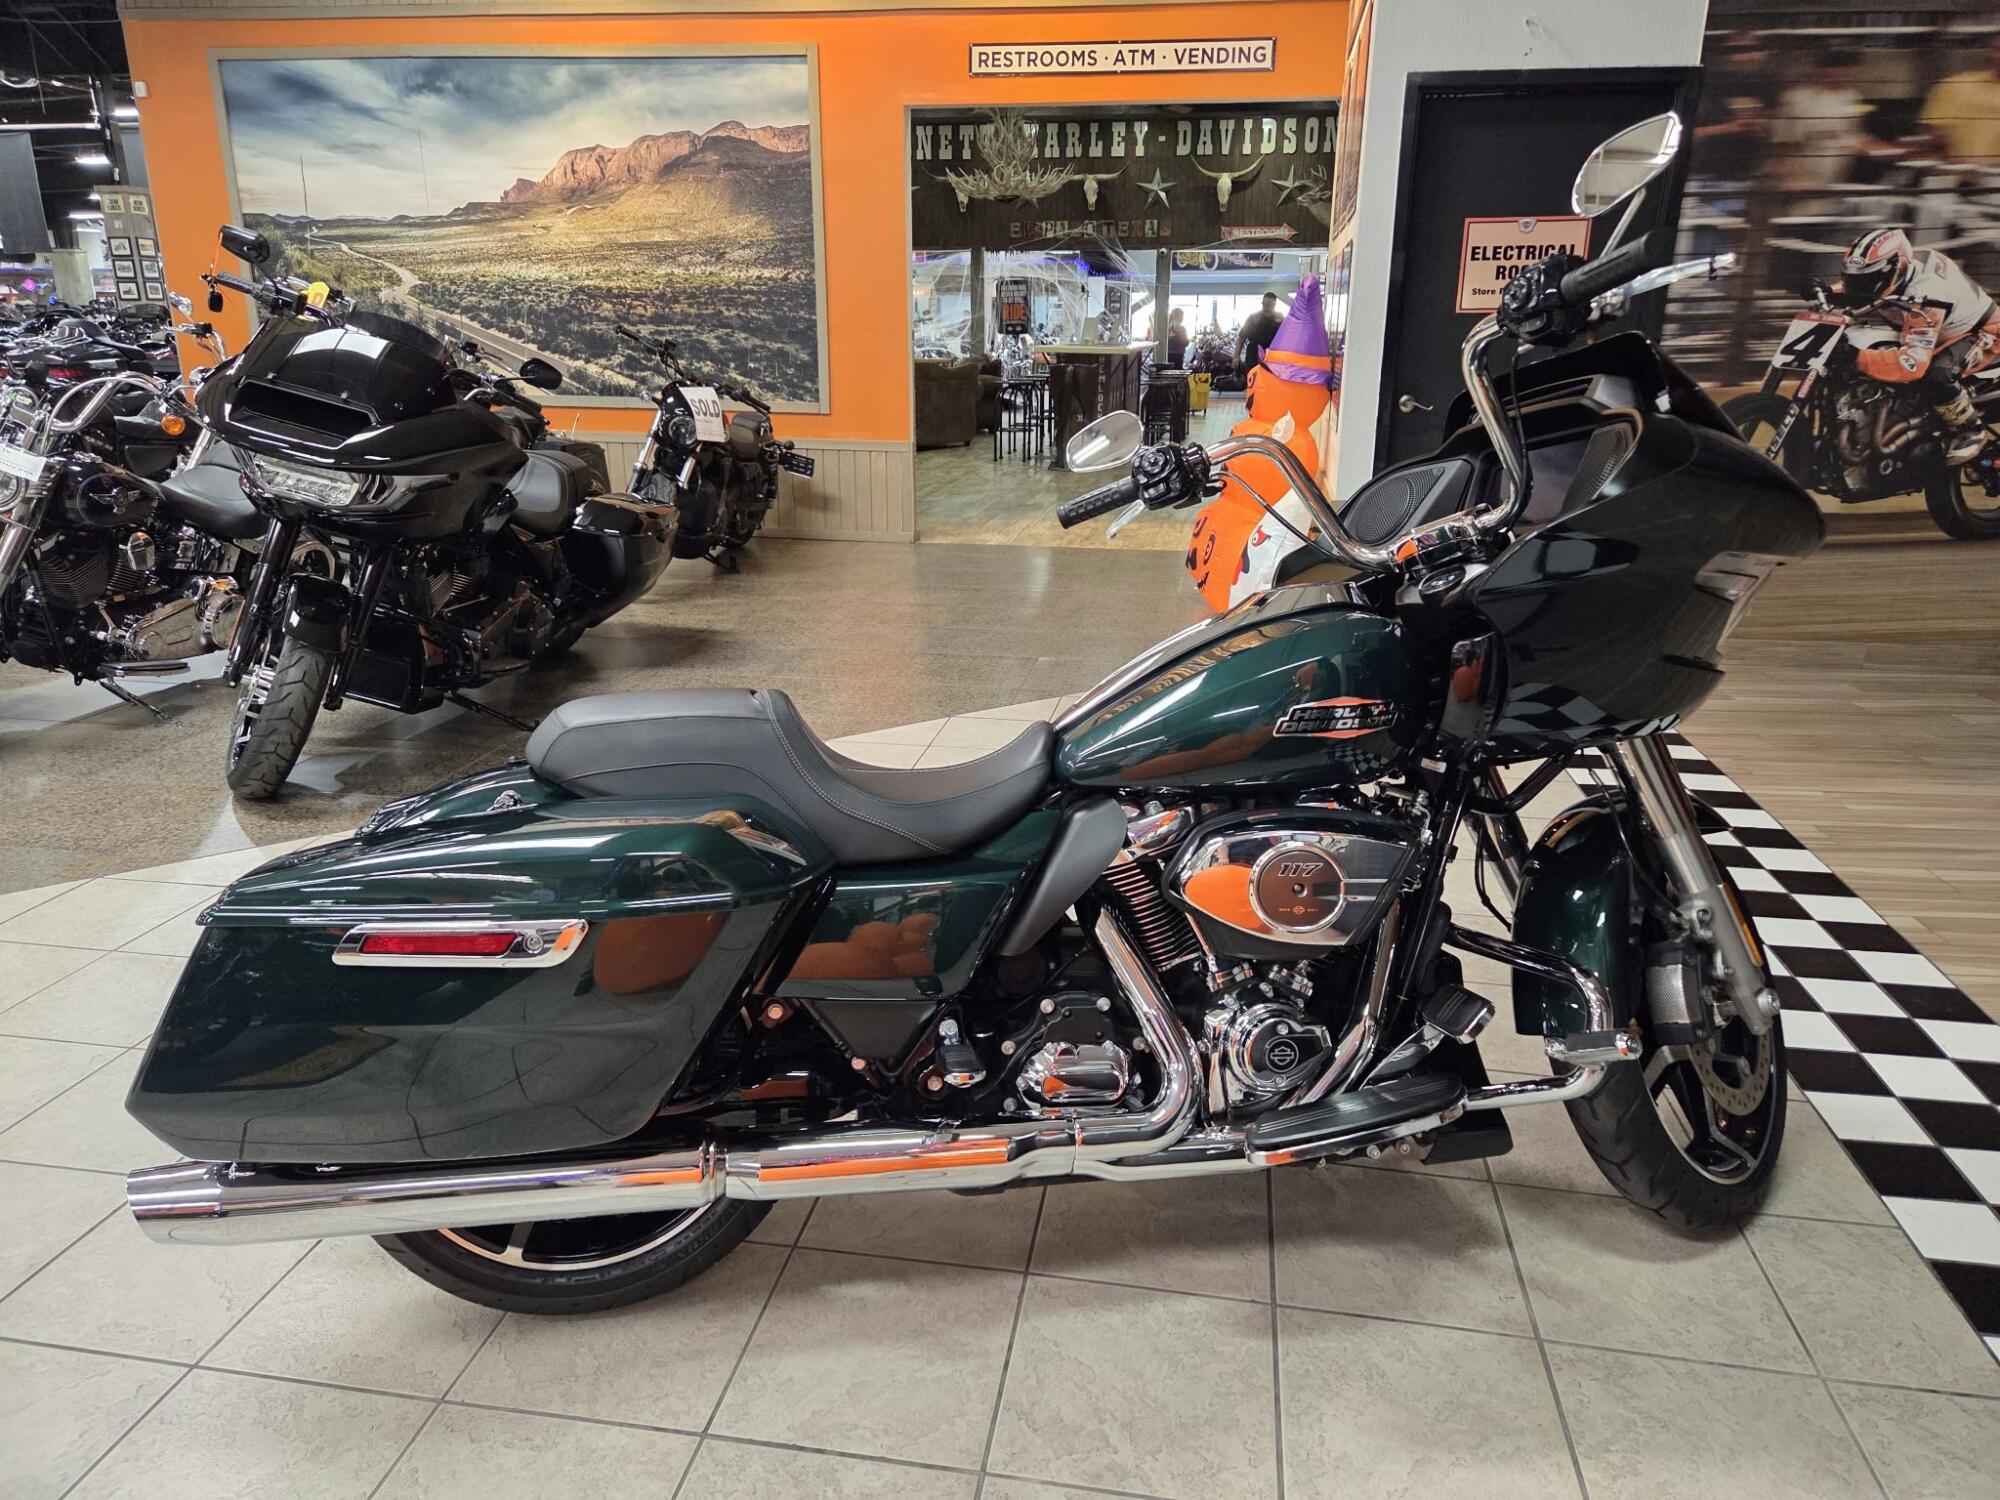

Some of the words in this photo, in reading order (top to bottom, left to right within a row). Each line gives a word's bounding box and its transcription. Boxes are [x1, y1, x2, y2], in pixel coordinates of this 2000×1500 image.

[978, 50, 1097, 68] RESTROOMS
[1113, 48, 1155, 66] ATM
[1174, 46, 1267, 65] VENDING
[1470, 244, 1576, 261] ELECTRICAL
[1780, 323, 1841, 370] 4
[690, 398, 721, 418] SOLD
[1278, 862, 1324, 877] 117
